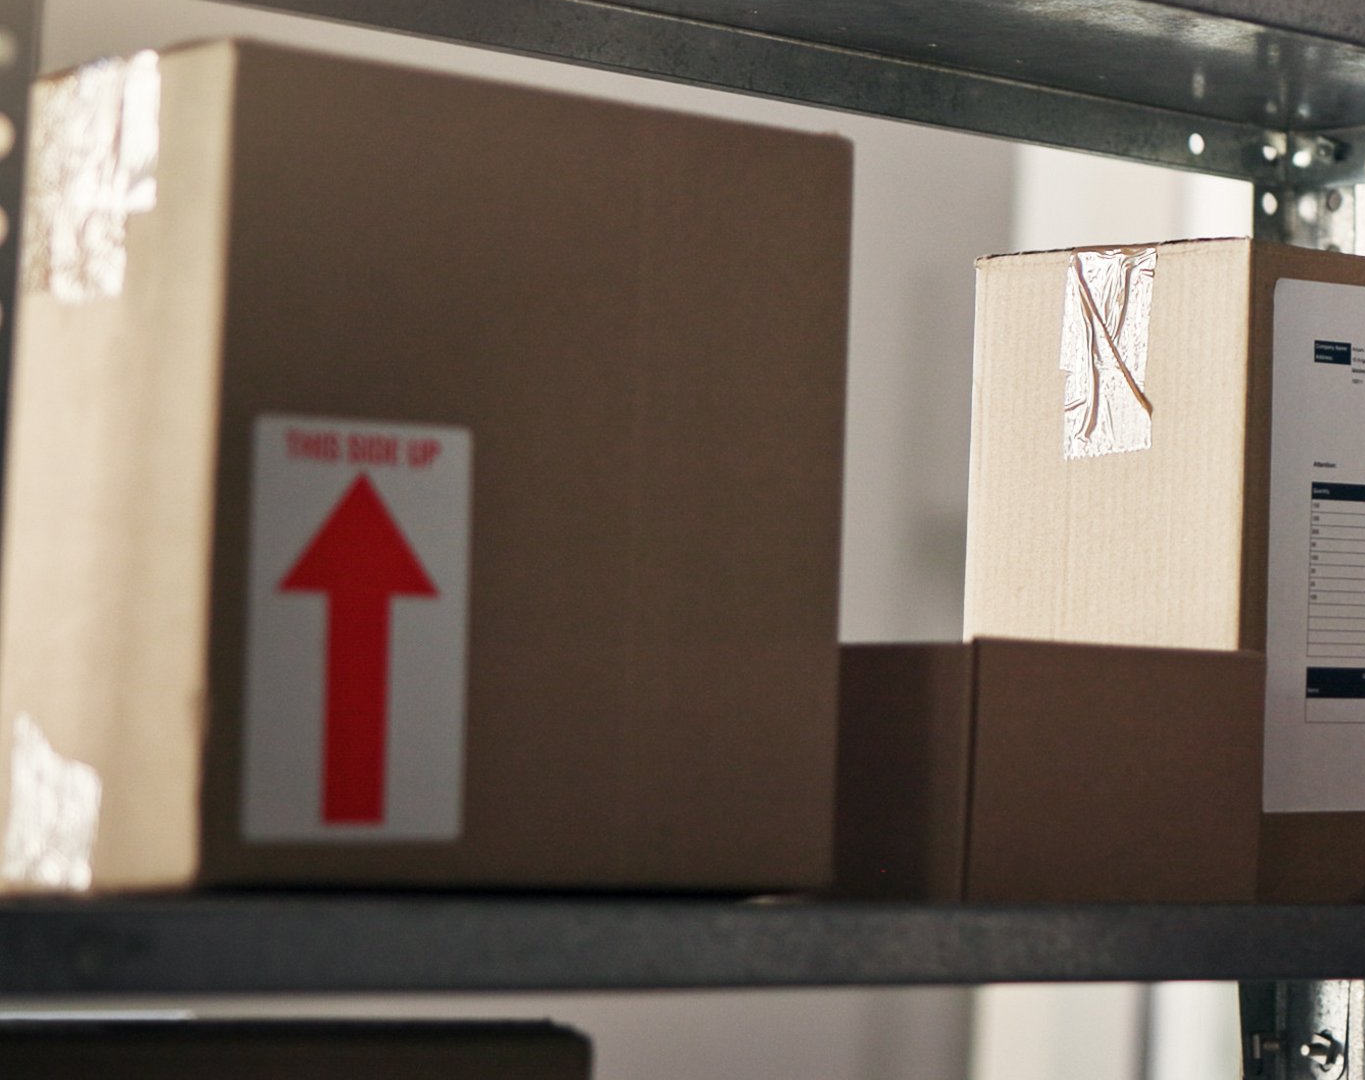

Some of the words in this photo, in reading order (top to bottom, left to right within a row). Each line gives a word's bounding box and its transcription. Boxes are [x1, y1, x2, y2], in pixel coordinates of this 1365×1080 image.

[285, 427, 340, 464] THIS
[347, 433, 399, 467] SIDE
[406, 437, 442, 469] UP
